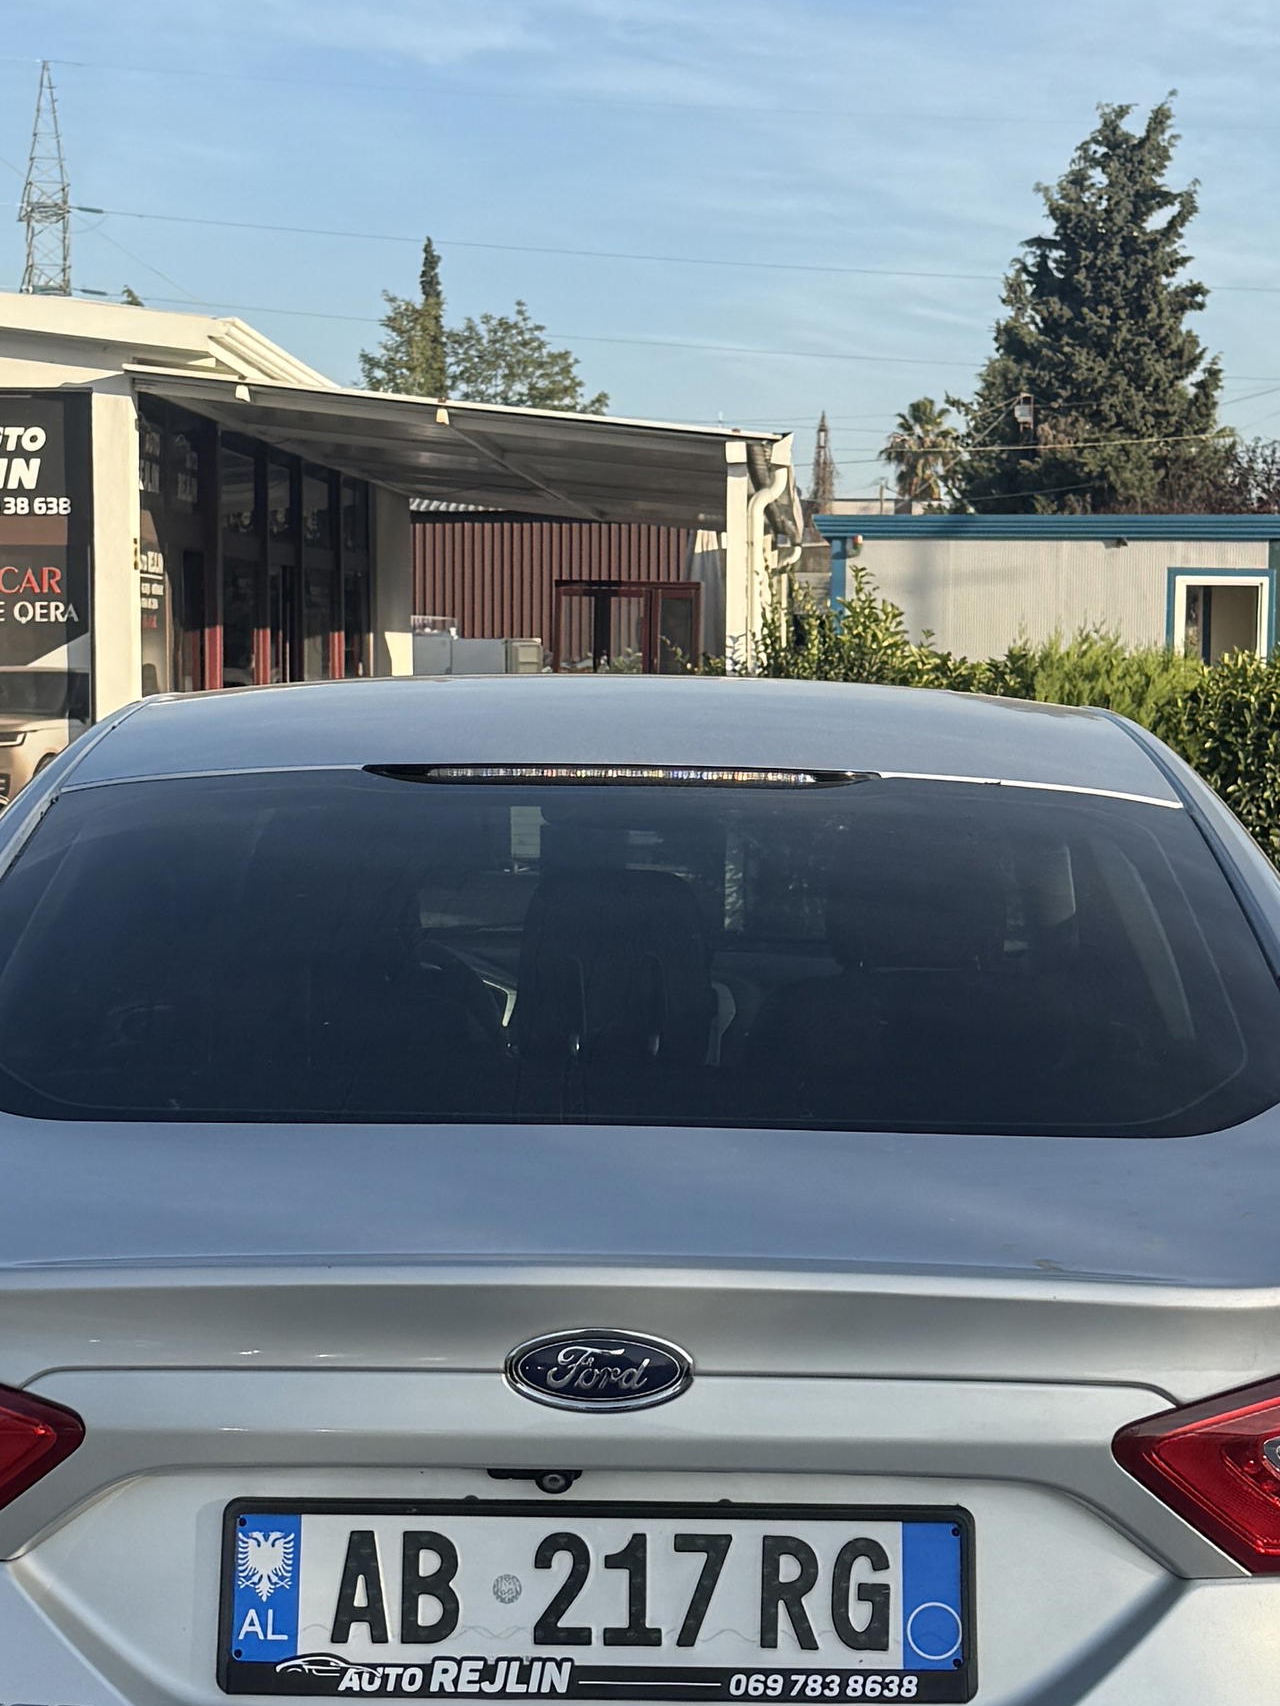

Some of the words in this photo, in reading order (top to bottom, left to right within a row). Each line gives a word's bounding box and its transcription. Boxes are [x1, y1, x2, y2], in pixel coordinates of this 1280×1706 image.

[3, 496, 30, 515] 38
[33, 496, 72, 516] 638
[13, 601, 79, 624] QERA
[546, 1345, 651, 1390] Ford
[330, 1529, 461, 1644] AB
[532, 1531, 734, 1647] 217
[759, 1534, 892, 1652] RG
[237, 1608, 289, 1641] AL
[337, 1667, 423, 1693] AUTO
[429, 1659, 572, 1695] REJLIN
[728, 1673, 784, 1697] 069
[789, 1674, 841, 1698] 783
[845, 1675, 919, 1699] 8638
